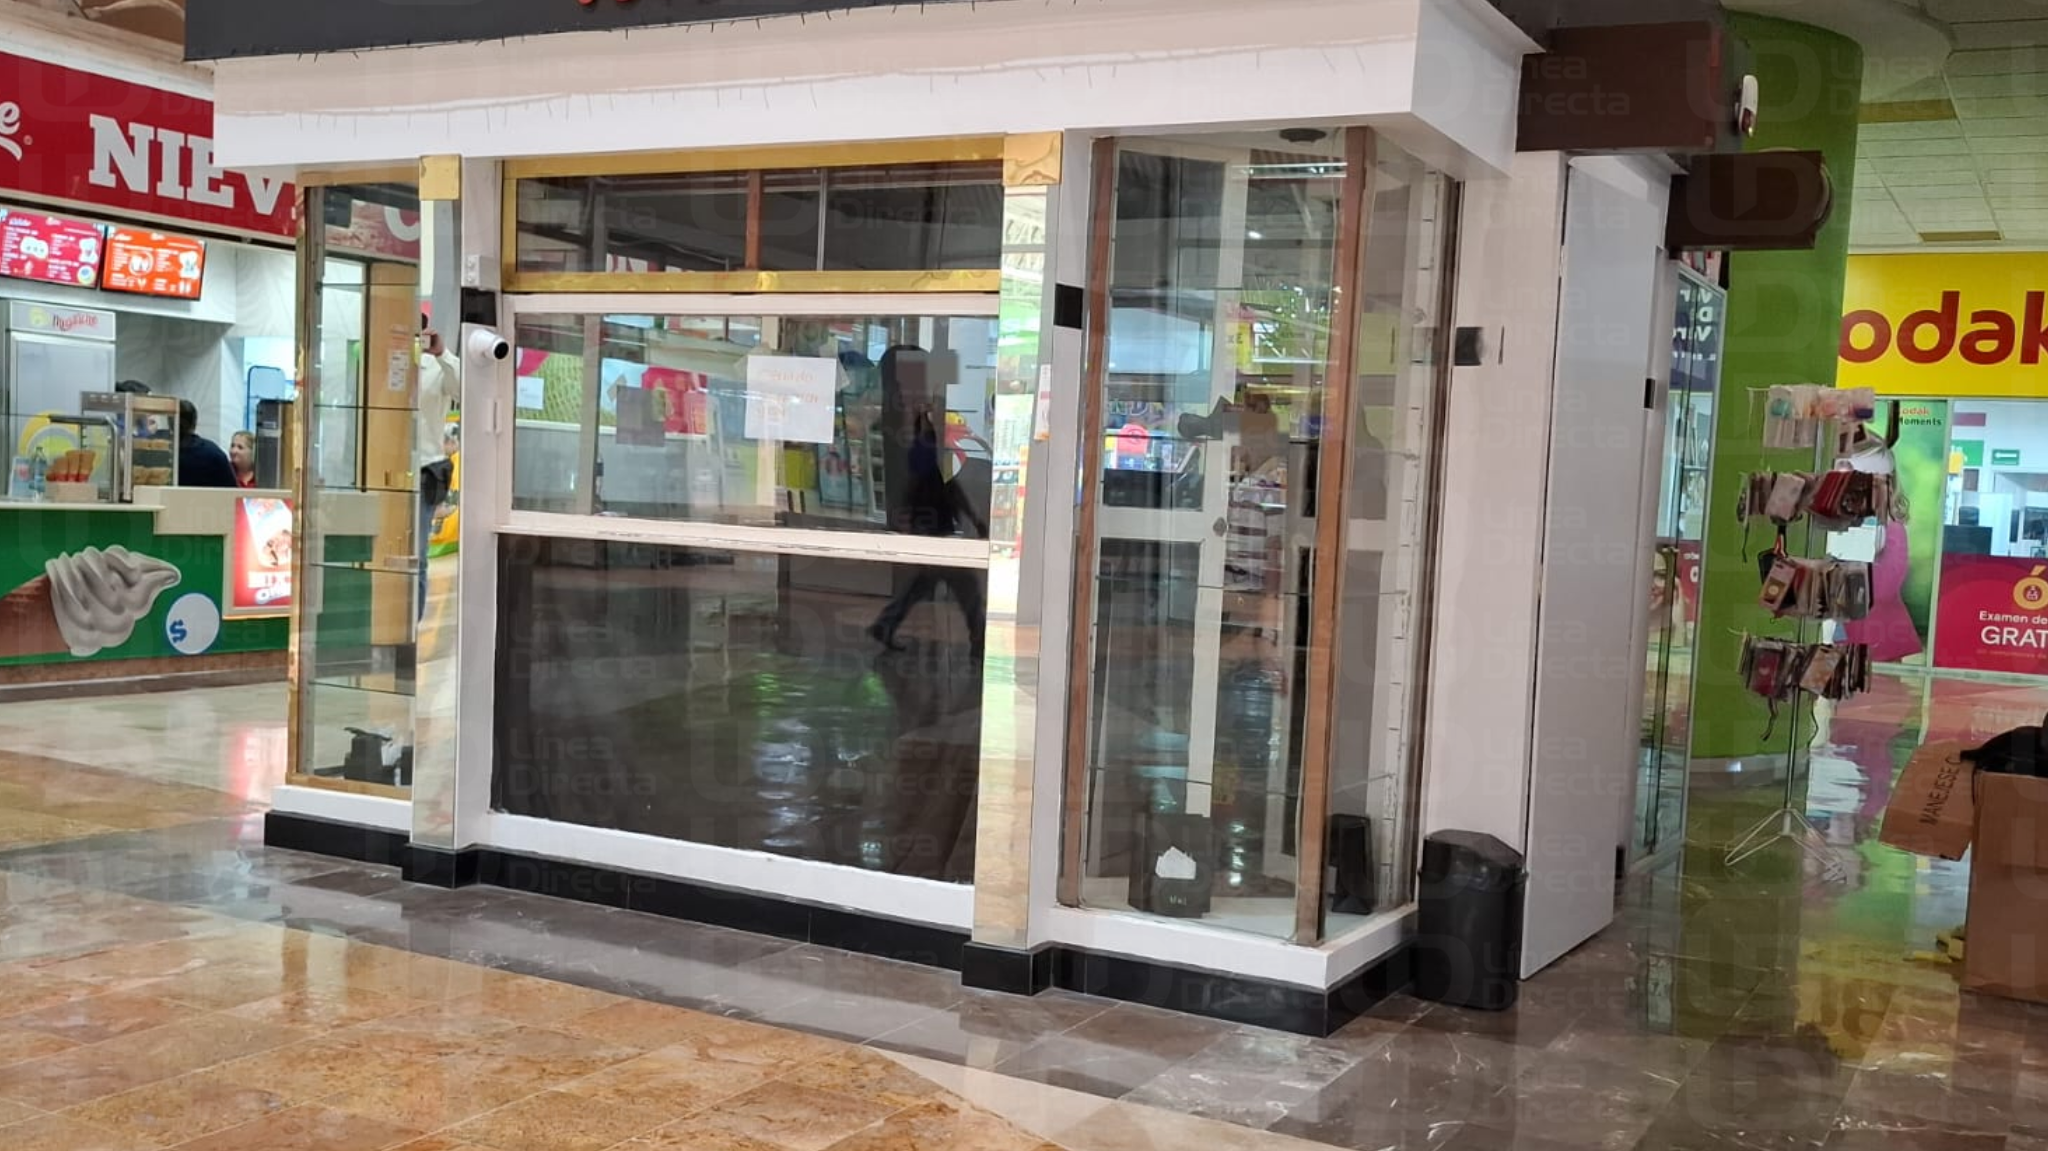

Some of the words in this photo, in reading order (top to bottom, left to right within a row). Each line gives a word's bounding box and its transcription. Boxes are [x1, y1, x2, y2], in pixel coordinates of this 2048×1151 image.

[1900, 407, 1929, 415] odak
[1979, 610, 2029, 624] Examen
[1980, 625, 2048, 650] GRAT
